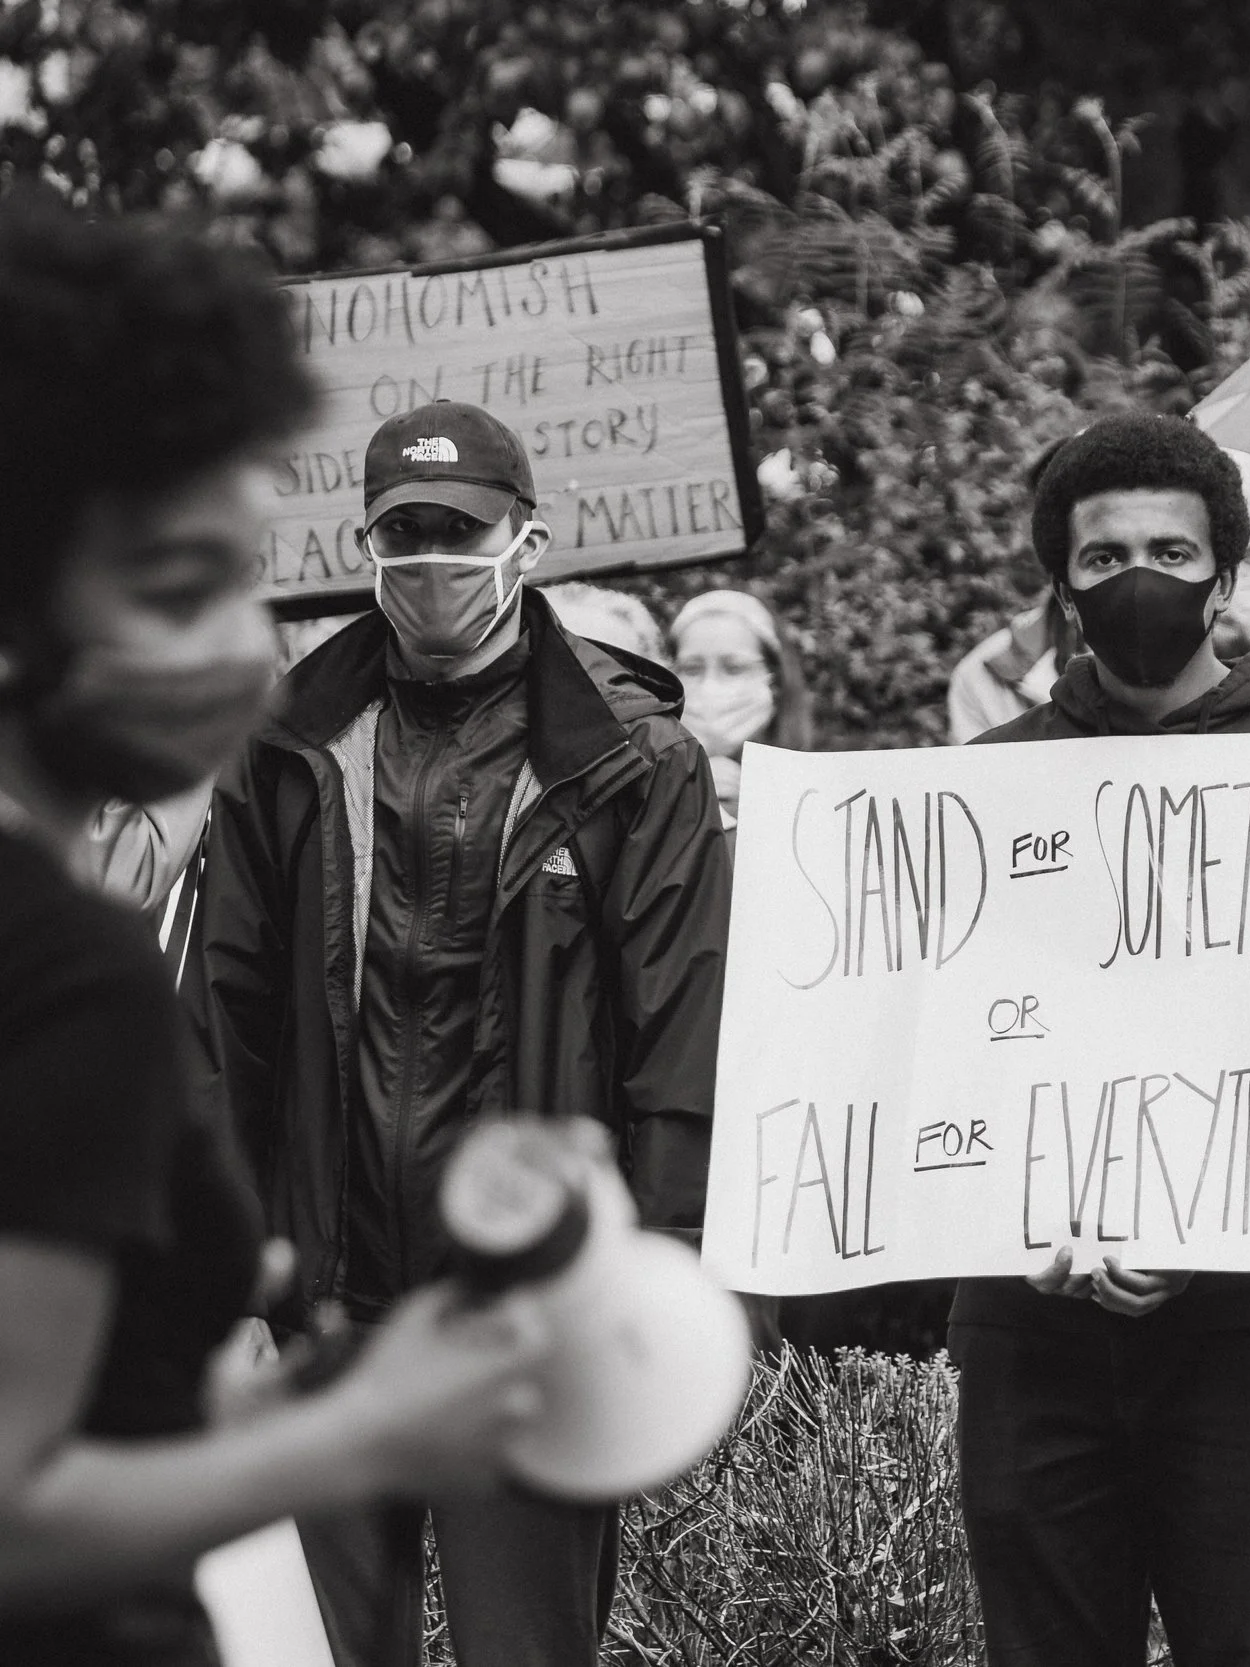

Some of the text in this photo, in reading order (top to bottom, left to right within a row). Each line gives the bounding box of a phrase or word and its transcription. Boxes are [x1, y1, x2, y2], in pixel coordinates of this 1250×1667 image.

[370, 334, 697, 416] ON THE RIGHT
[273, 403, 658, 496] SIDE STORY
[402, 445, 439, 457] NORTH
[417, 437, 439, 446] THE
[250, 518, 364, 586] LAC
[542, 862, 564, 874] FACE
[776, 788, 987, 990] STAND
[1011, 829, 1073, 870] FOR
[987, 994, 1051, 1034] OR
[752, 1098, 885, 1268] FALL
[915, 1119, 994, 1164] FOR
